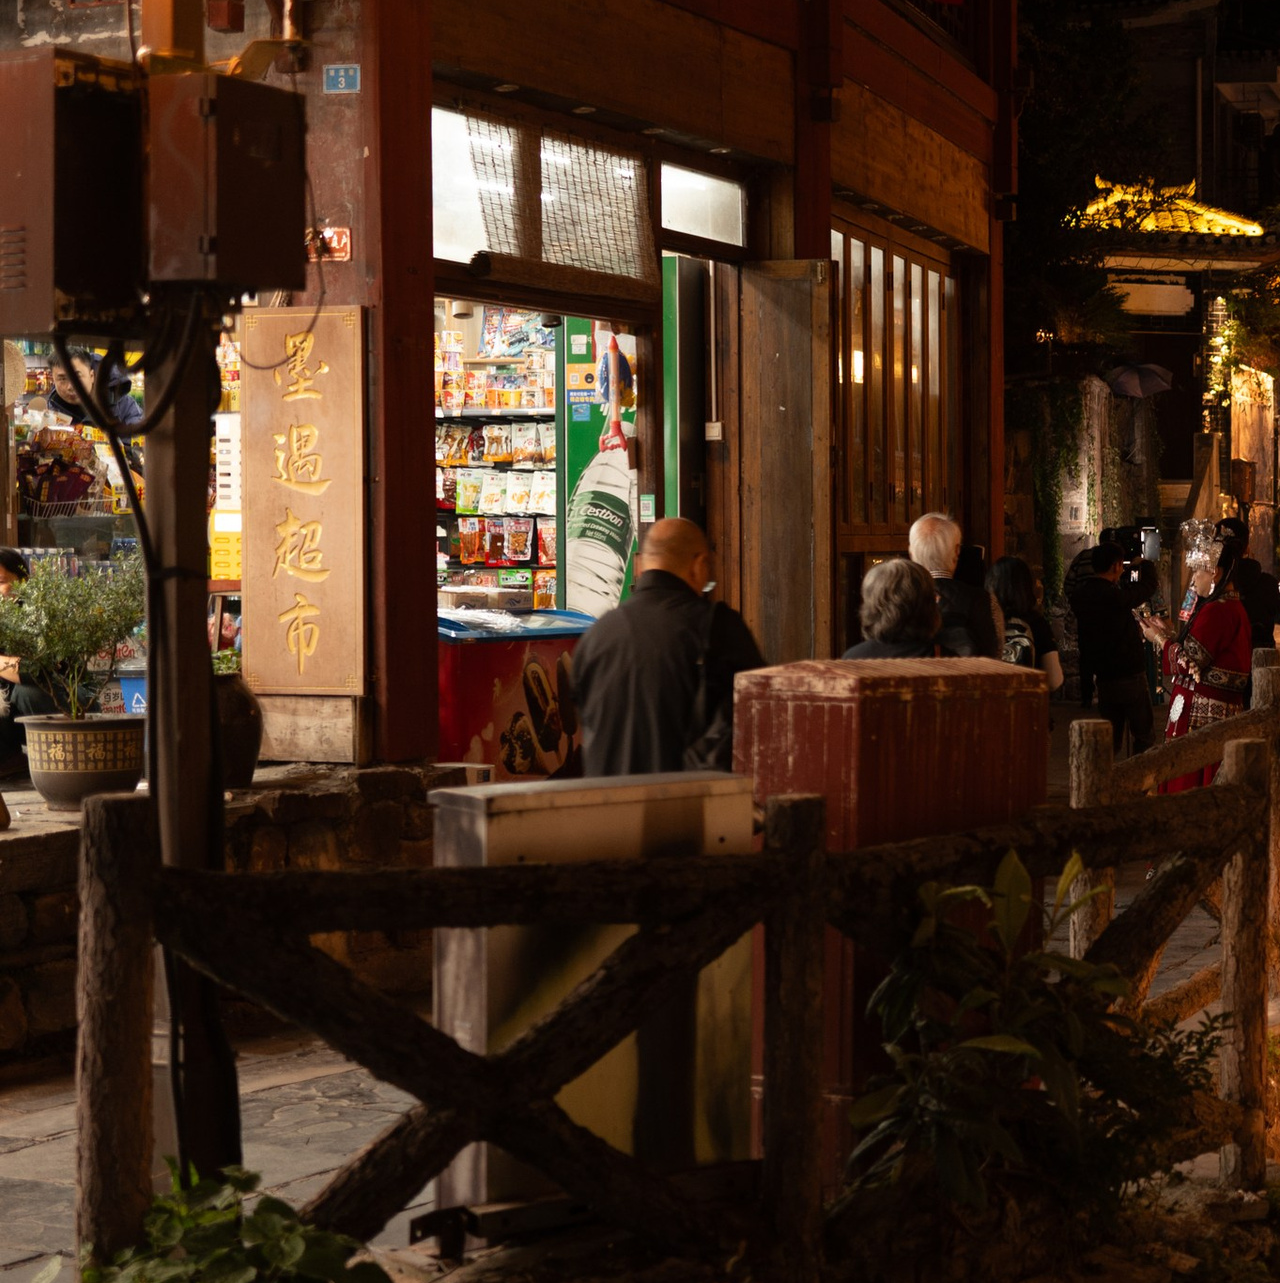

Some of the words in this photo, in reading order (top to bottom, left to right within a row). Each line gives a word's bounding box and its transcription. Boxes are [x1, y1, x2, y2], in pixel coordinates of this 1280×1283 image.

[338, 77, 346, 88] 3
[271, 330, 331, 676] 墨遇超市
[48, 743, 65, 761] 福
